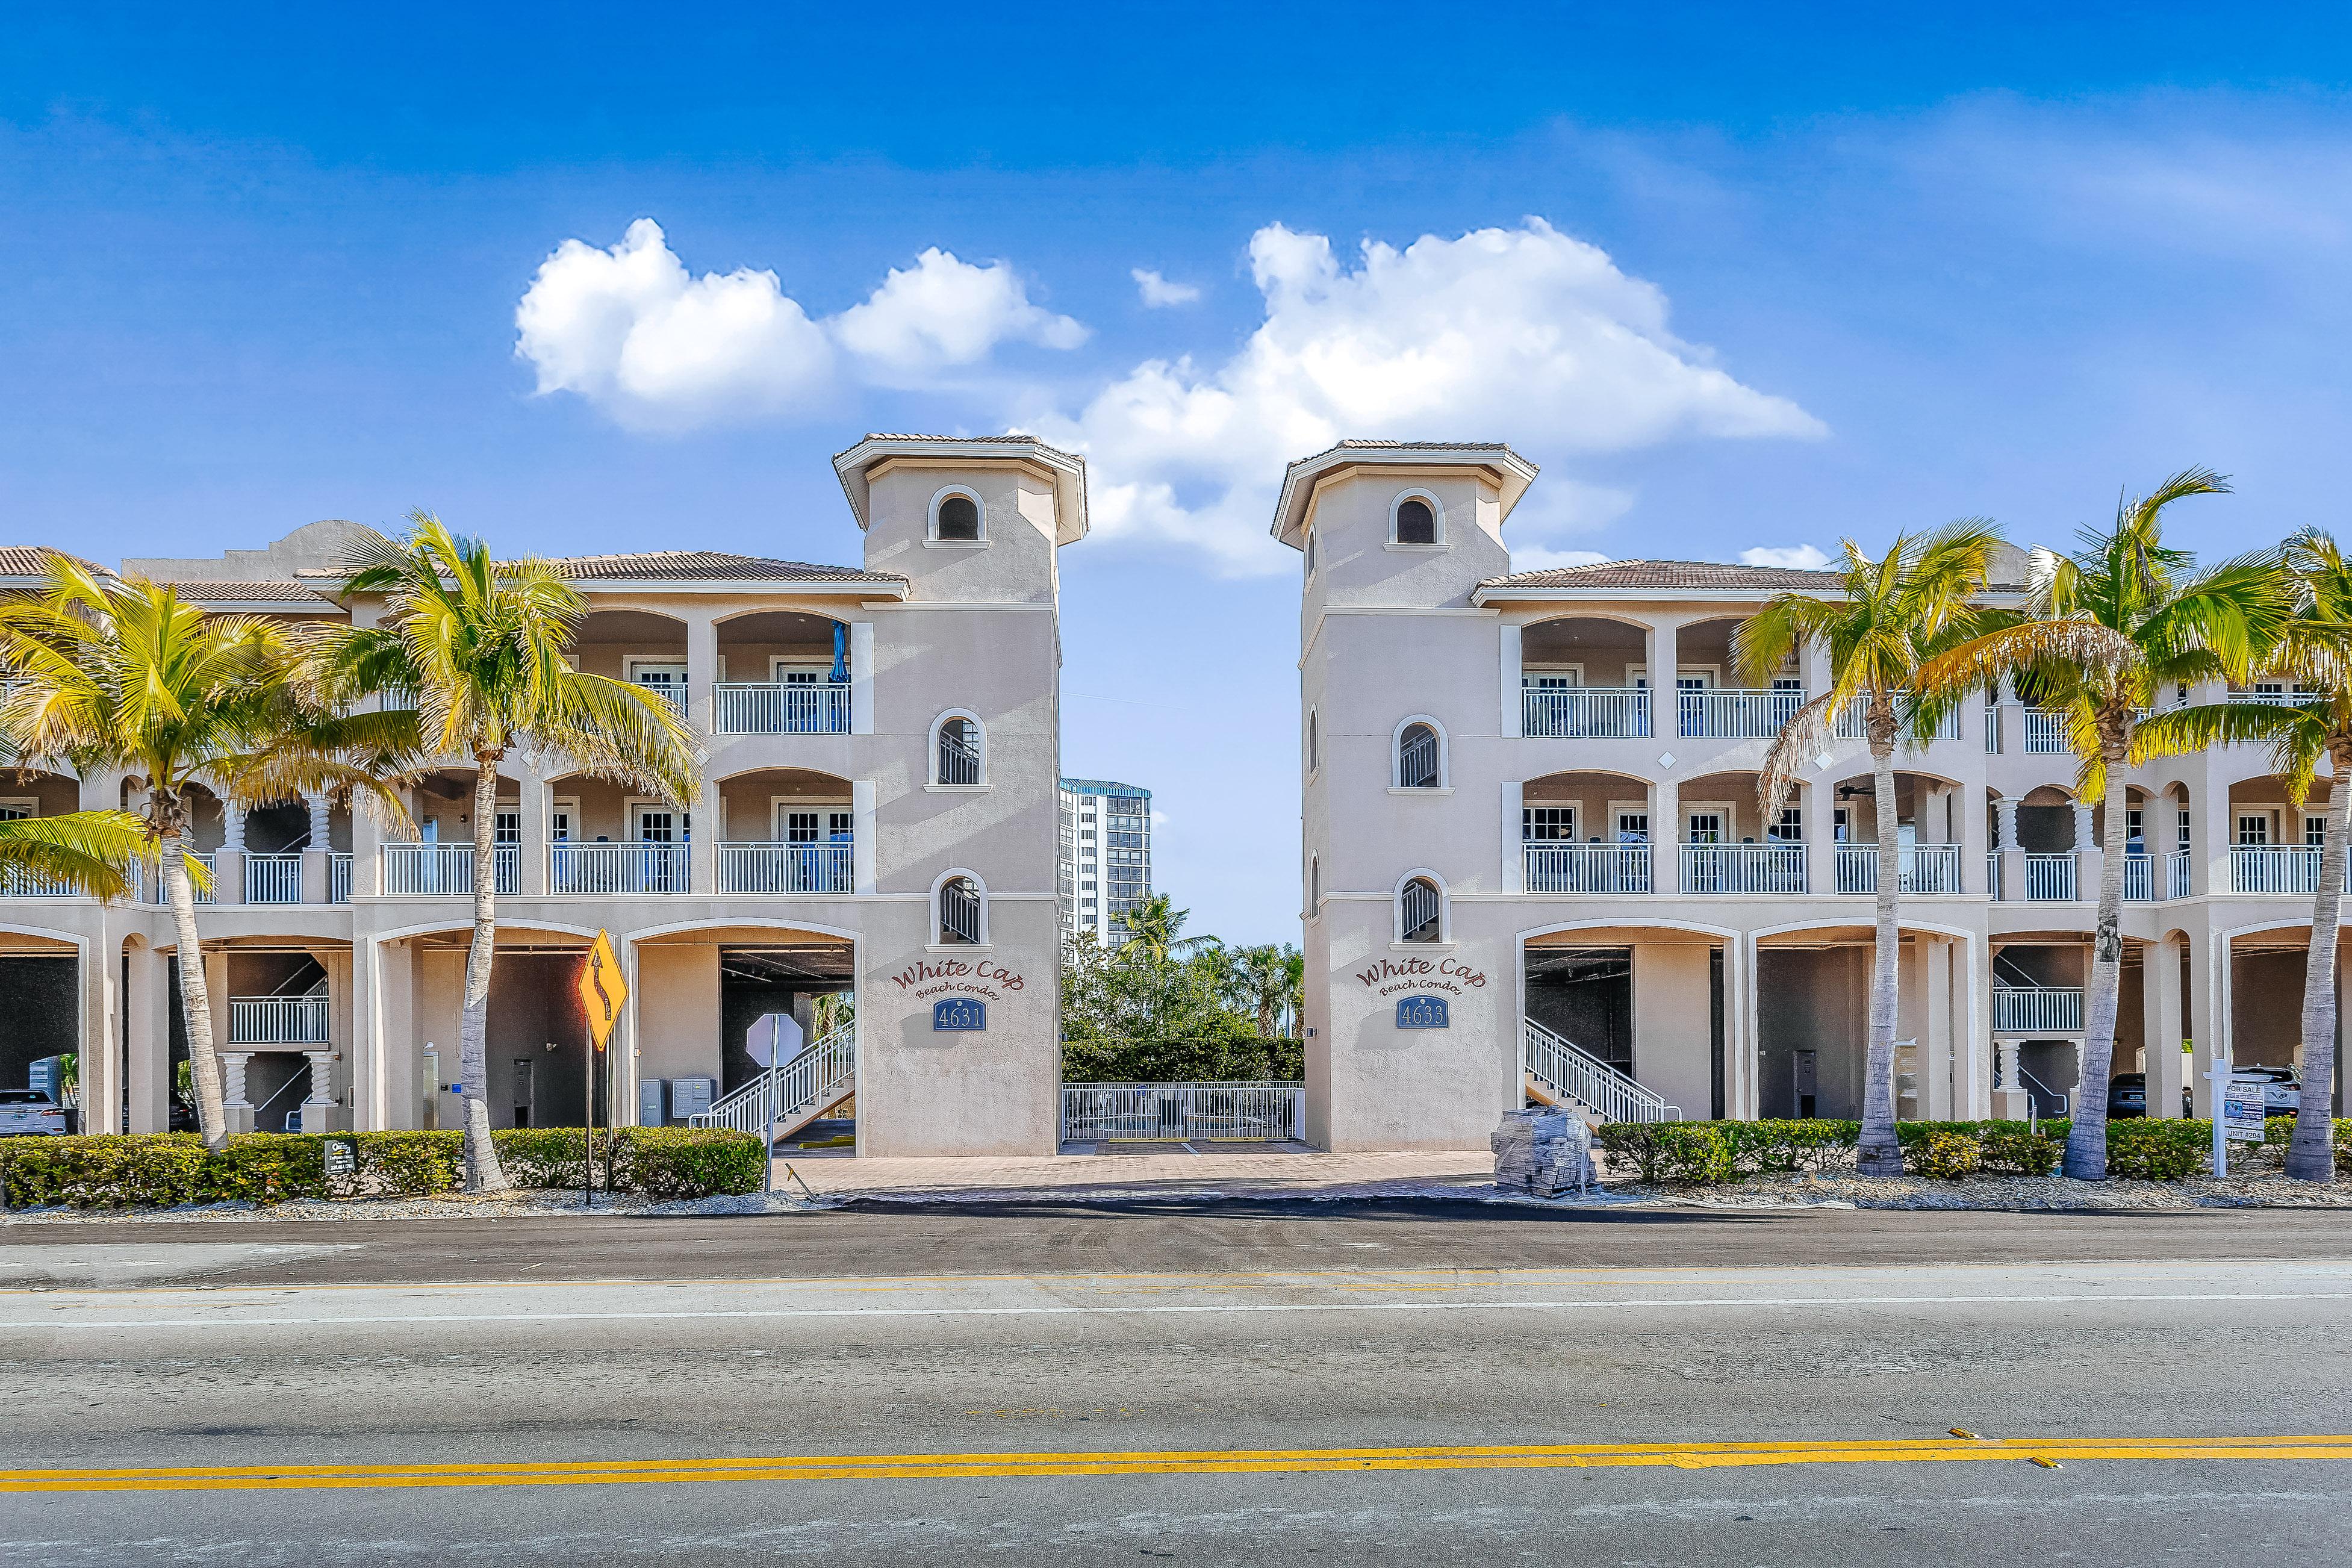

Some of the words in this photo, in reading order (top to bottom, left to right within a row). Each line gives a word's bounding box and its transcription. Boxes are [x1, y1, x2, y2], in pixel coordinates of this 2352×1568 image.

[891, 959, 973, 990] White
[977, 960, 1024, 991] Cap
[1356, 957, 1436, 987] White
[1439, 958, 1486, 988] Cap
[915, 982, 956, 1000] Beach
[956, 982, 1000, 1001] Condos
[1379, 979, 1418, 997] Beach
[1419, 980, 1462, 995] Condos
[938, 1007, 981, 1027] 4631
[1402, 1006, 1443, 1024] 4633
